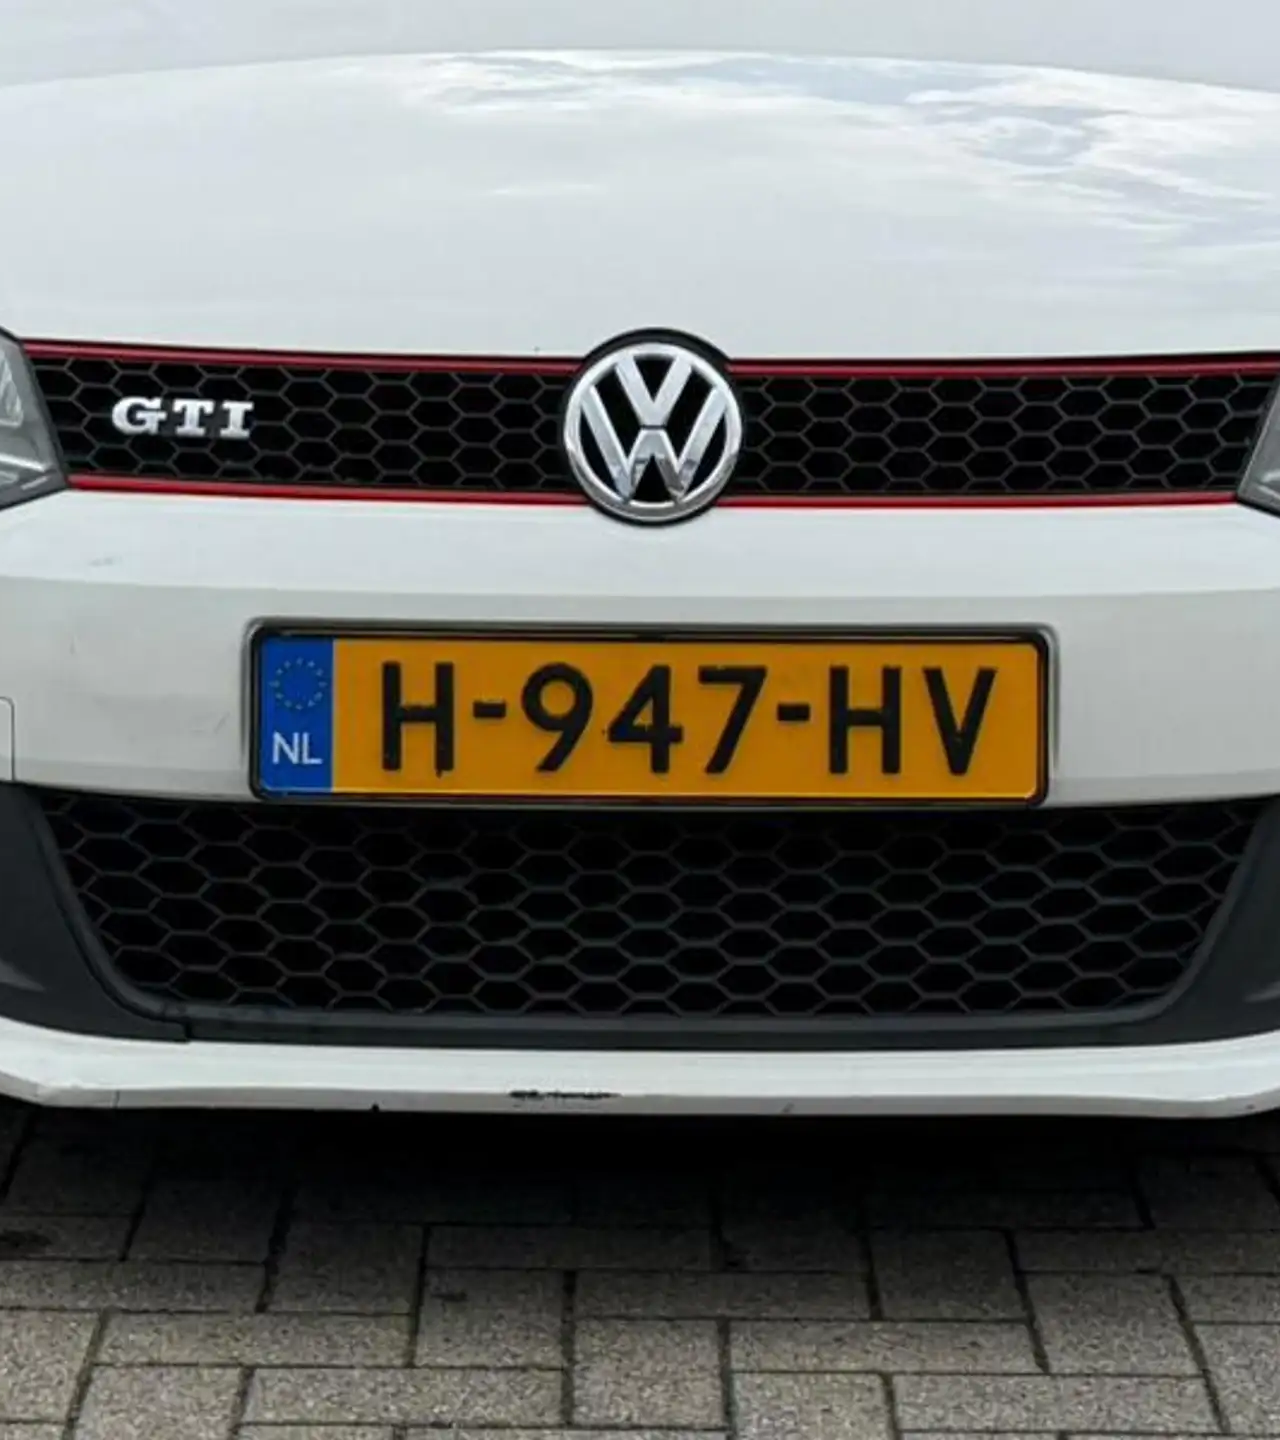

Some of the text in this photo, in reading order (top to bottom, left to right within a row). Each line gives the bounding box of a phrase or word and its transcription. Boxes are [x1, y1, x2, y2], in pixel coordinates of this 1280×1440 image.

[111, 396, 254, 439] GTI
[381, 661, 996, 775] H-947-HV
[272, 732, 322, 765] NL
